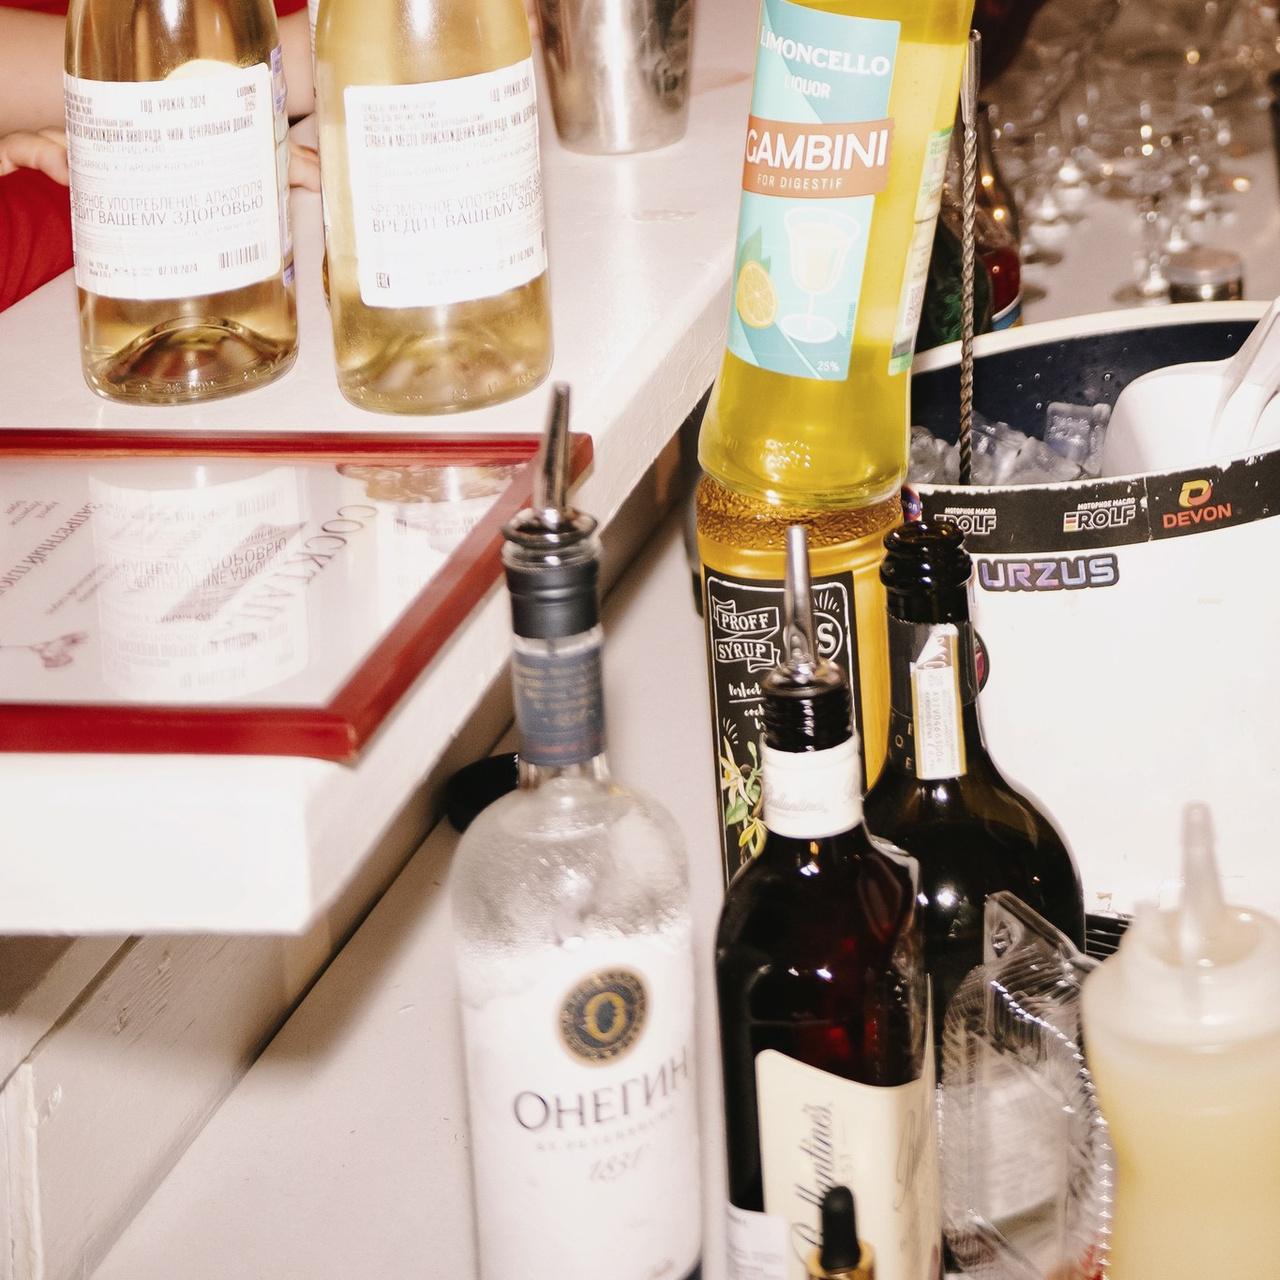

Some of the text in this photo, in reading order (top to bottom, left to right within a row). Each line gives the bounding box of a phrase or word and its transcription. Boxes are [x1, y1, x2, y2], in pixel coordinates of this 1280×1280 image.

[760, 25, 891, 77] LIMONCELLO
[784, 73, 831, 100] LIQUOR
[745, 128, 889, 171] GAMBINI
[206, 180, 263, 205] АЛКОГОЛЯ
[757, 173, 844, 190] FOR DIGESTIF
[98, 210, 167, 227] ВАШЕМУ
[173, 194, 264, 226] ЗДОРОВЬЮ
[817, 361, 840, 372] 25%
[1077, 497, 1136, 511] МОТОРНОЕ МАСЛО
[1163, 502, 1232, 530] DEVON
[1076, 505, 1137, 531] ROLF
[980, 556, 1116, 589] URZUS
[721, 613, 769, 631] PROFF
[718, 642, 767, 659] SYRUP
[728, 682, 762, 698] Perfect
[513, 1045, 690, 1131] ОНЕГИН
